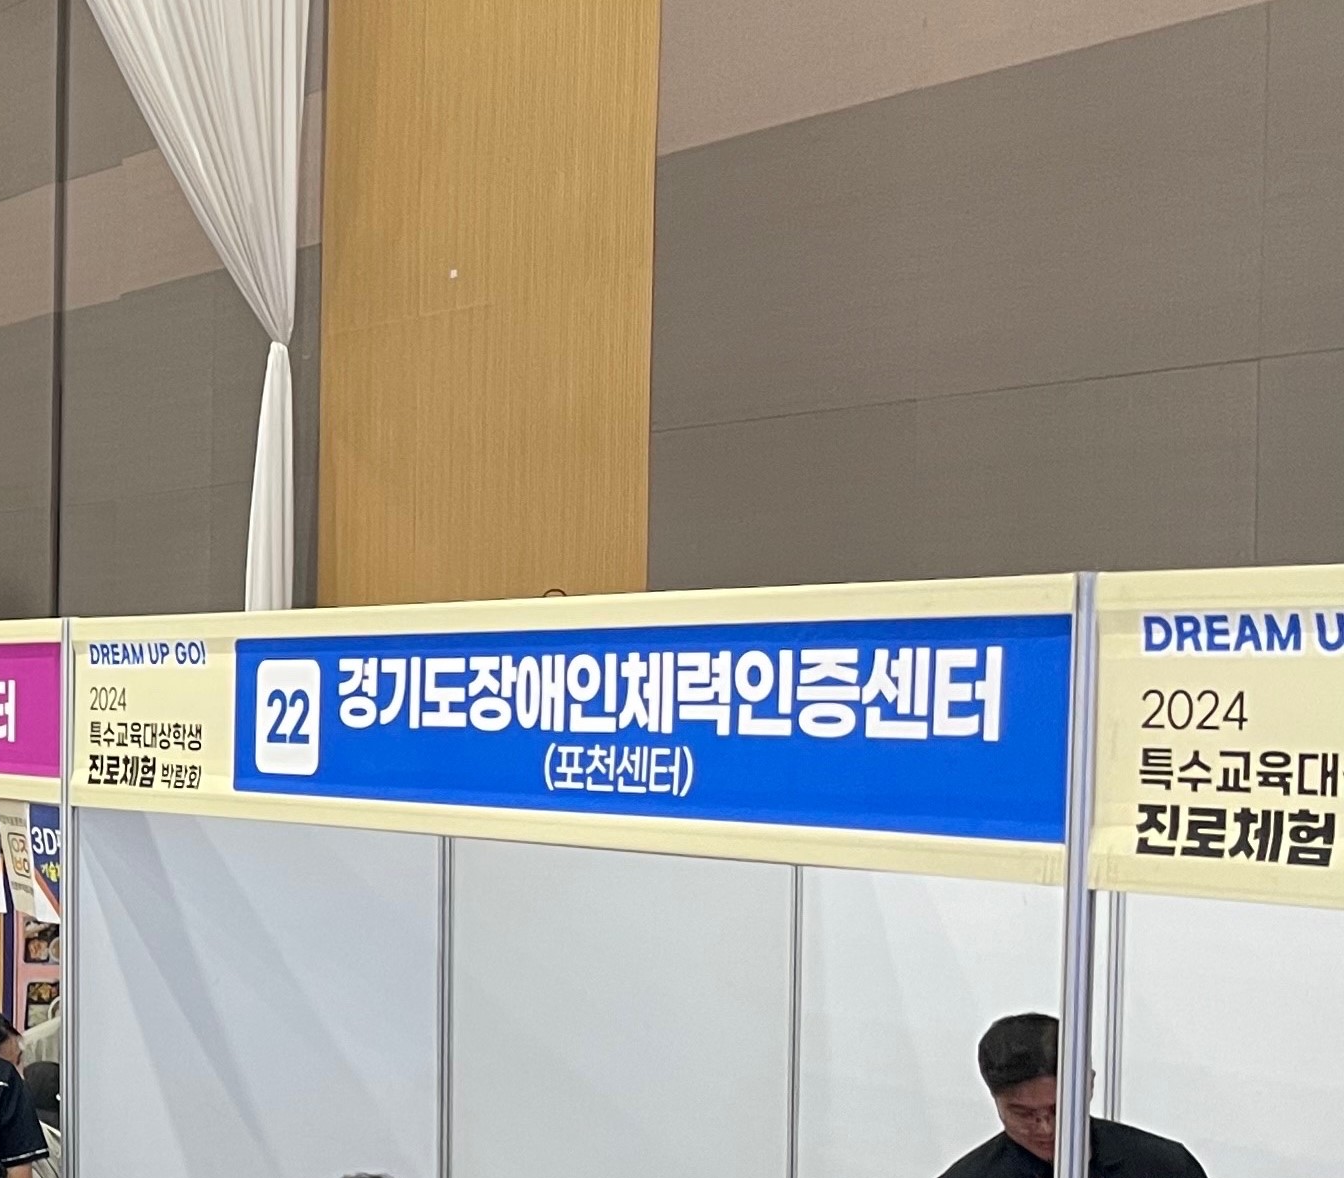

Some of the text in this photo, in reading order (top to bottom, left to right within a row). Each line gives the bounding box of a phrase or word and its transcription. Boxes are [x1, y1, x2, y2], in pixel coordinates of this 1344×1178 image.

[89, 640, 207, 667] DREAM UP GO!
[1144, 613, 1344, 653] DREAM U
[90, 686, 127, 712] 2024
[338, 645, 1002, 742] 경기도장애인체력인증센터
[1141, 689, 1249, 732] 2024
[88, 721, 203, 752] 특수교육대상학생
[267, 689, 310, 745] 22
[88, 755, 201, 791] 진로체험 박람회
[543, 742, 694, 797] (포천센터)
[1138, 747, 1344, 798] 특수교육대
[1136, 802, 1335, 868] 진로체험
